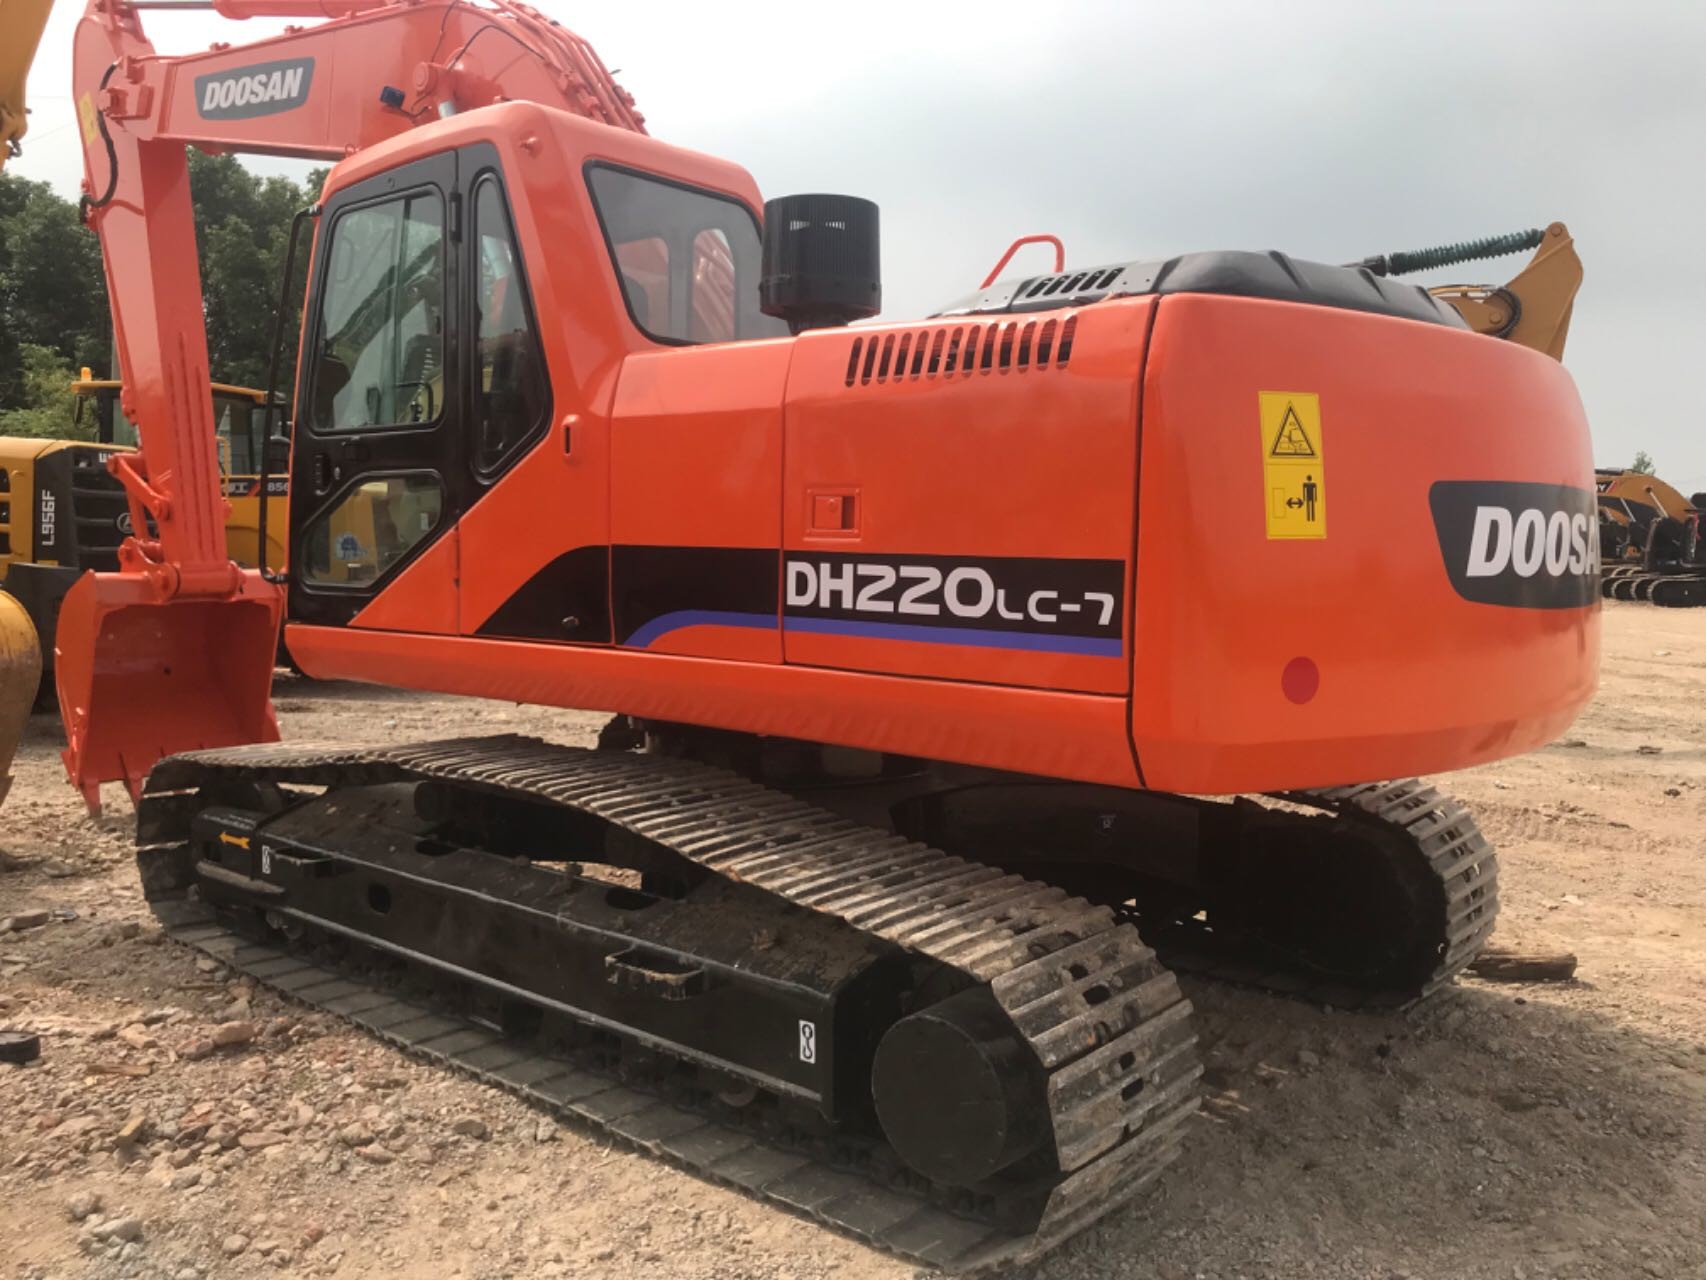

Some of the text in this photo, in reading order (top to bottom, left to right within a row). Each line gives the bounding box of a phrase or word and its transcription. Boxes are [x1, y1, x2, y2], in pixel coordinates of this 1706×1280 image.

[203, 67, 304, 111] DOOSAN
[41, 489, 56, 546] L956F
[1465, 505, 1601, 577] DOOSA
